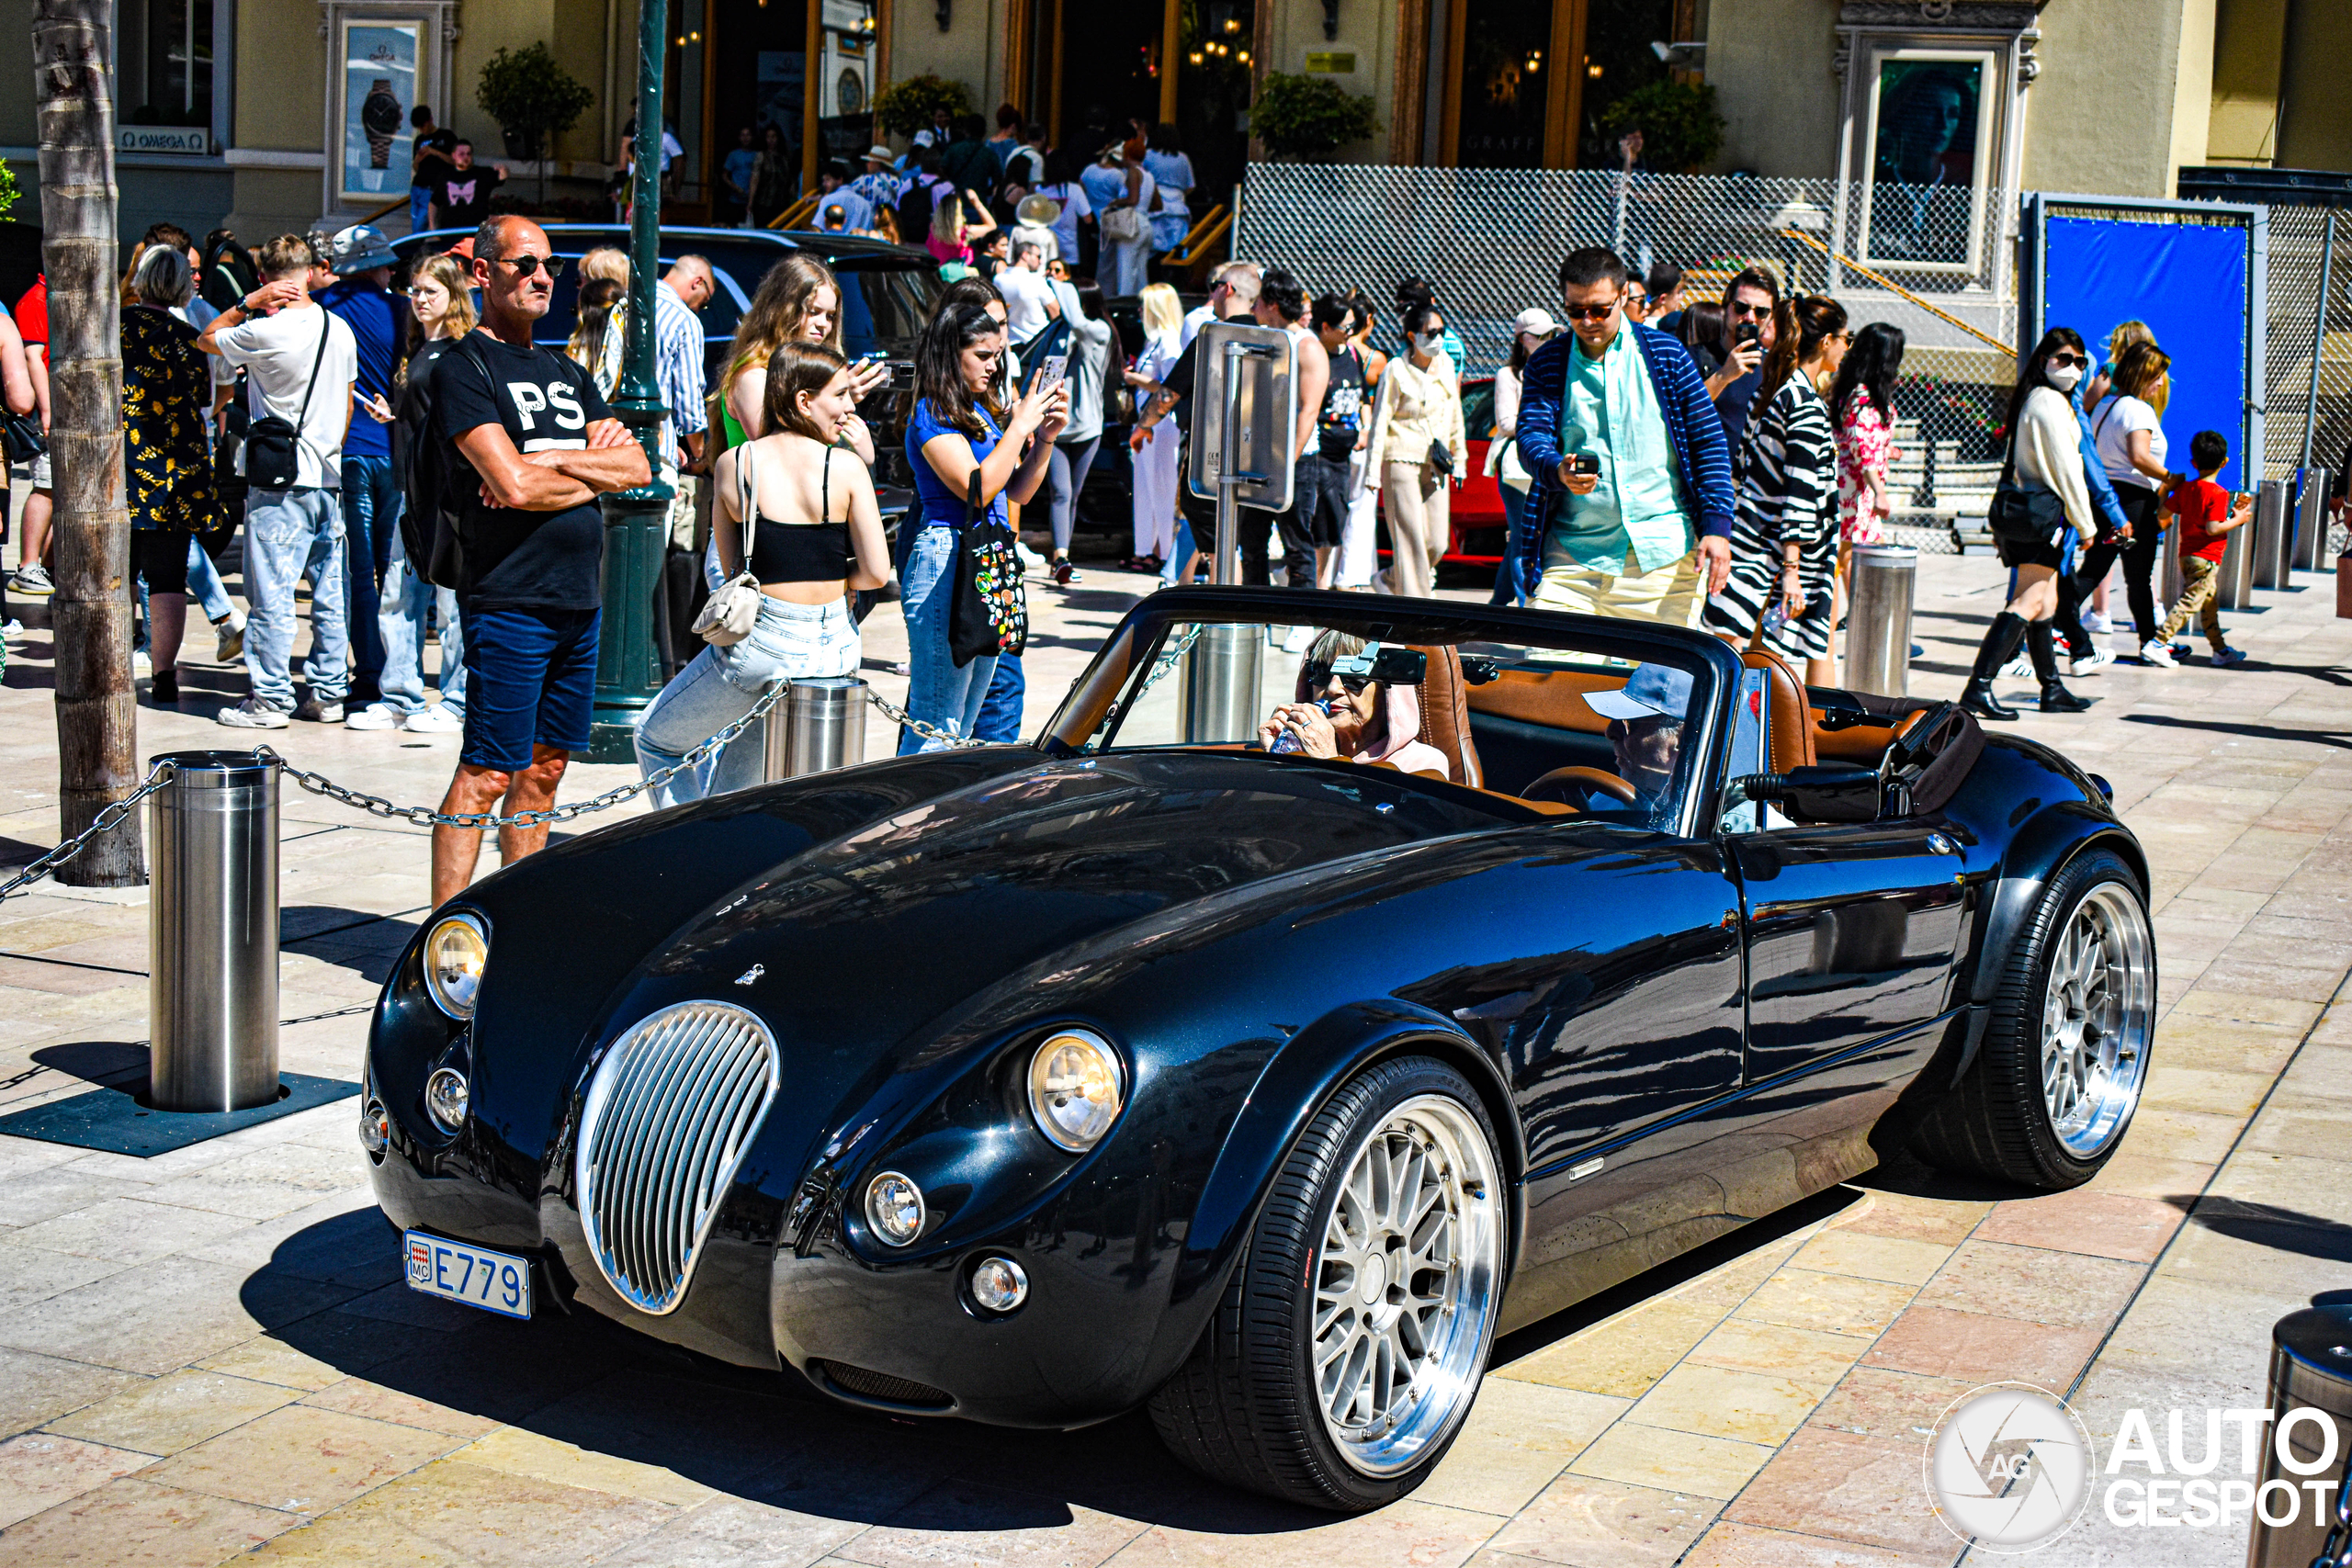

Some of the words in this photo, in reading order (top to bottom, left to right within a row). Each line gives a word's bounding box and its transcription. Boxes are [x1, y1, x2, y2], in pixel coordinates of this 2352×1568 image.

[139, 135, 186, 149] OMEGA
[1465, 135, 1535, 151] GRAFF
[506, 381, 586, 431] PS
[413, 1262, 429, 1278] MC
[435, 1247, 520, 1308] E779
